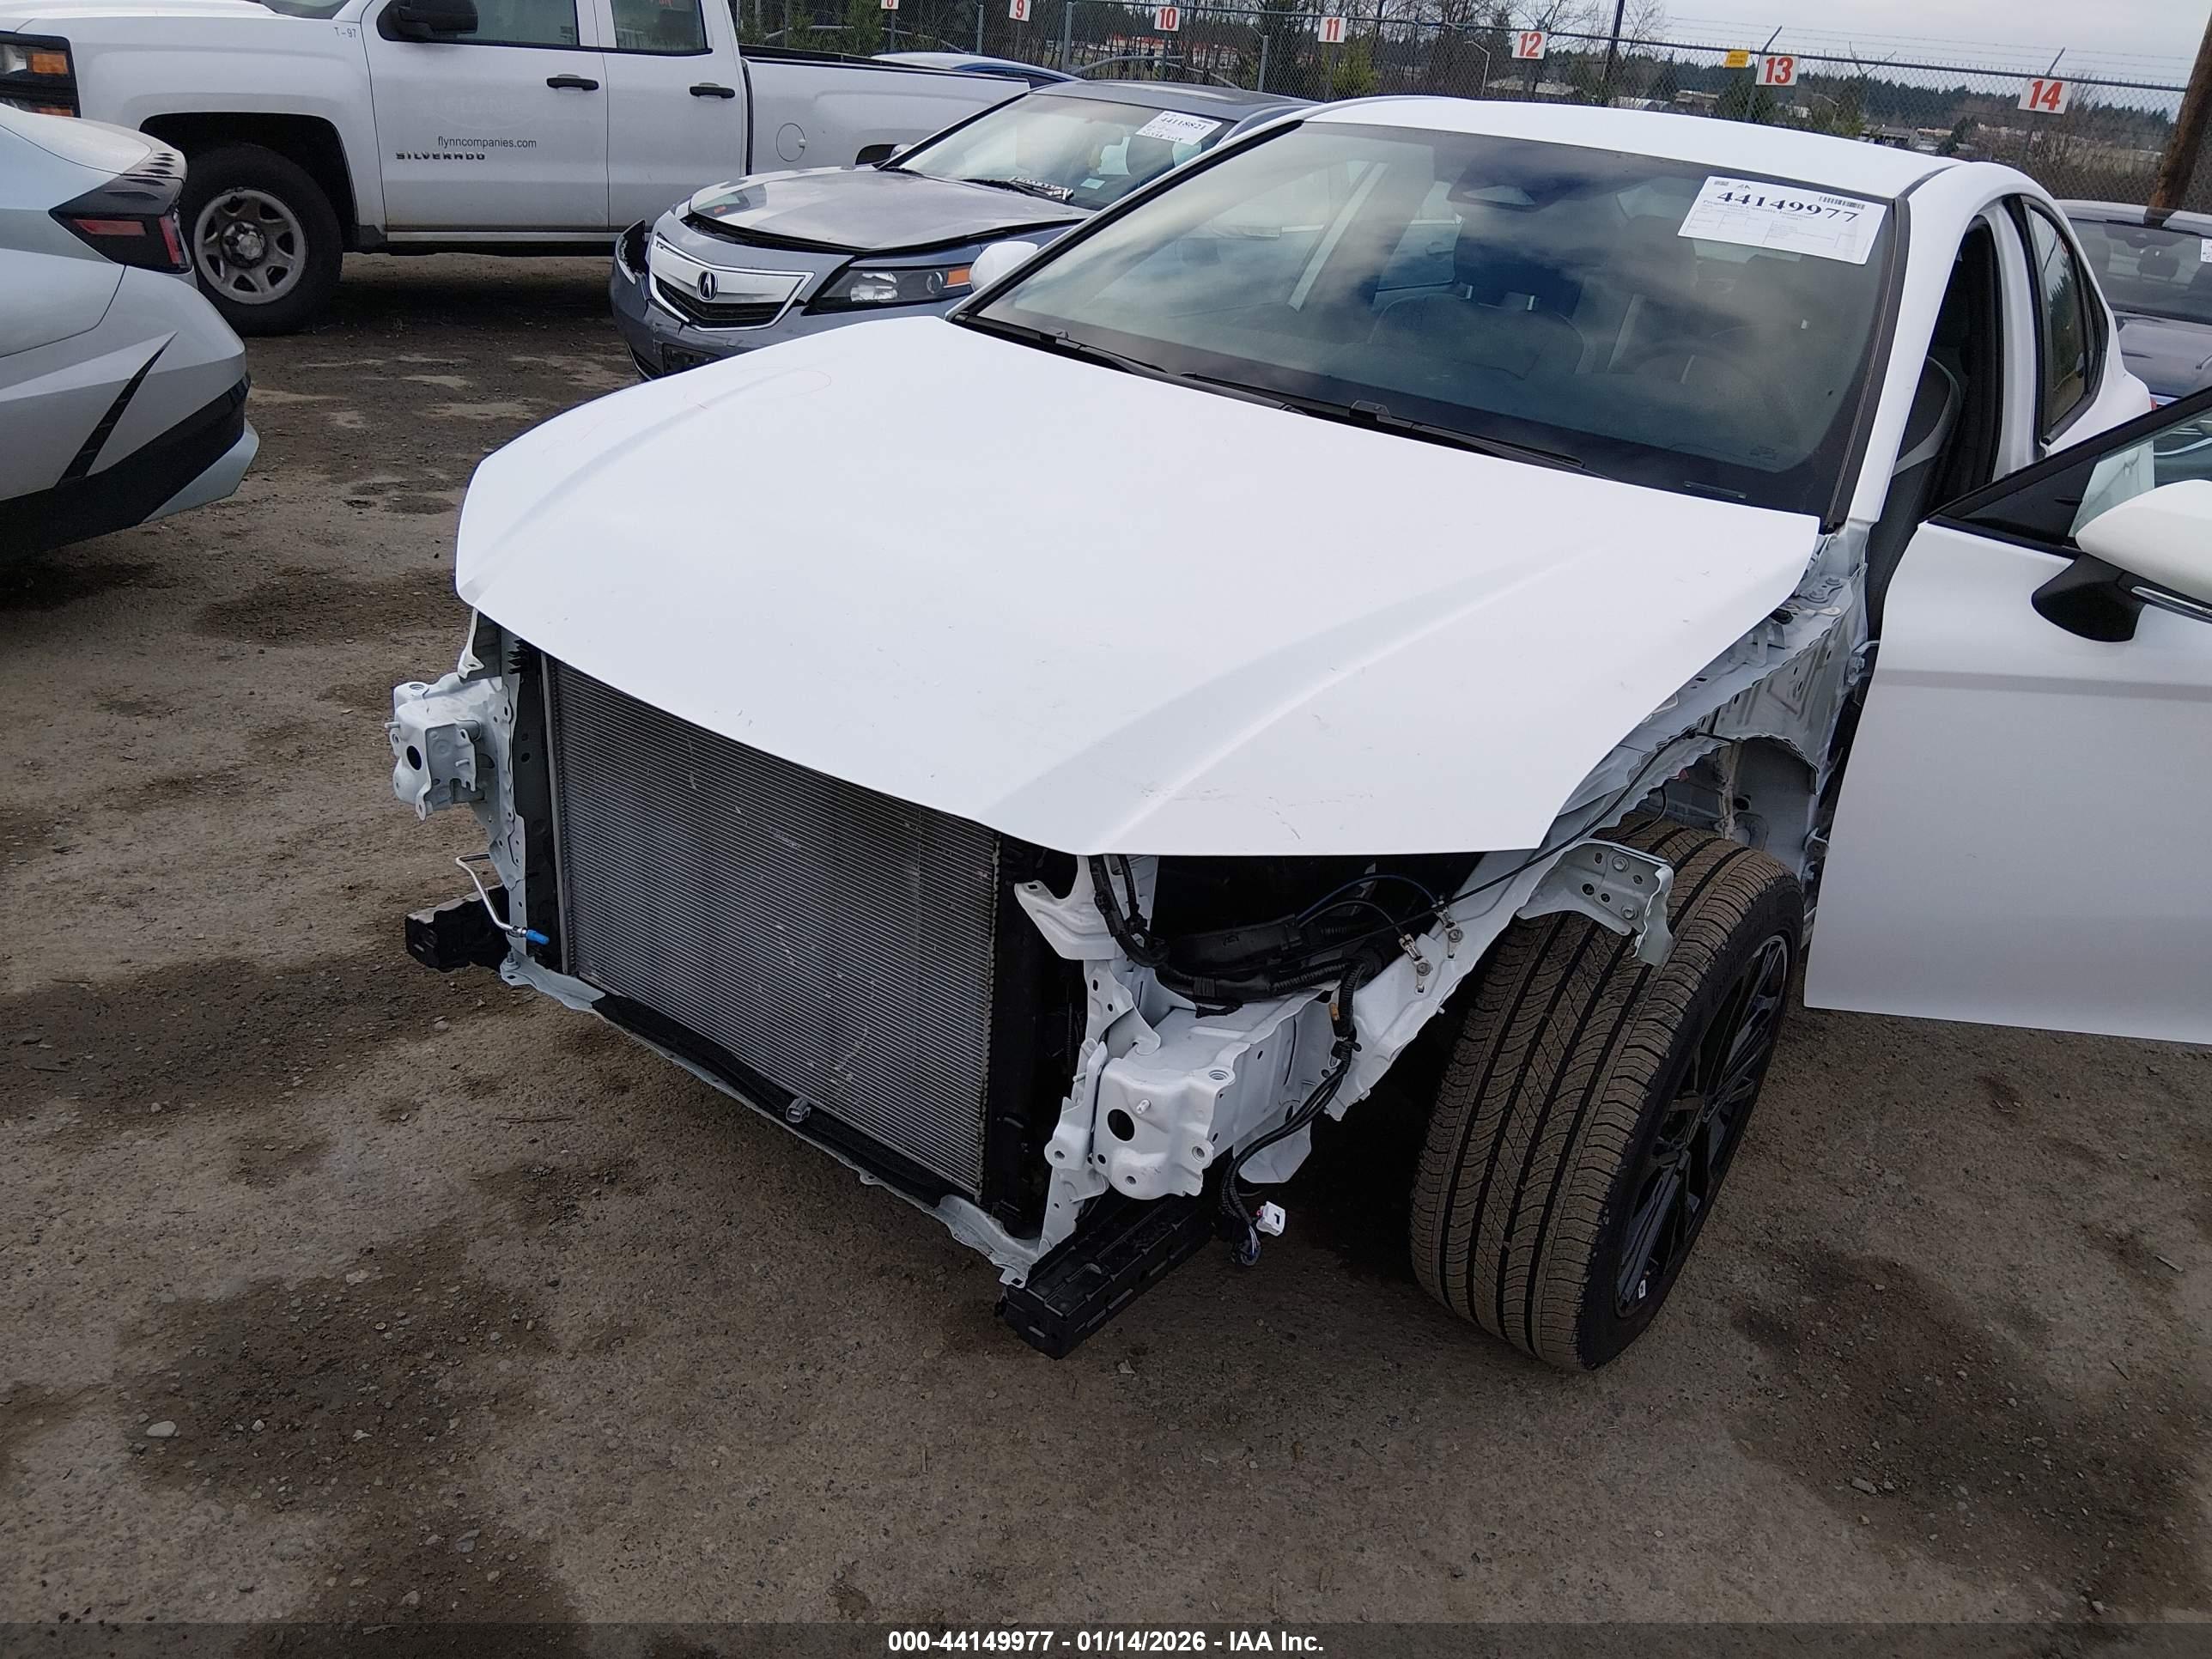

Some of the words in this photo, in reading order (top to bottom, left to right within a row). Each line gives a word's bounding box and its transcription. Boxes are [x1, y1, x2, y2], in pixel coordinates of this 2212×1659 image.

[1015, 0, 1024, 18] 9
[1159, 8, 1176, 29] 10
[1326, 18, 1340, 40] 11
[1519, 32, 1542, 57] 12
[1765, 57, 1794, 83] 13
[2029, 80, 2063, 111] 14
[437, 136, 537, 149] flynncompanies.com
[396, 152, 485, 161] SILVERADO
[1717, 191, 1859, 222] 44149977
